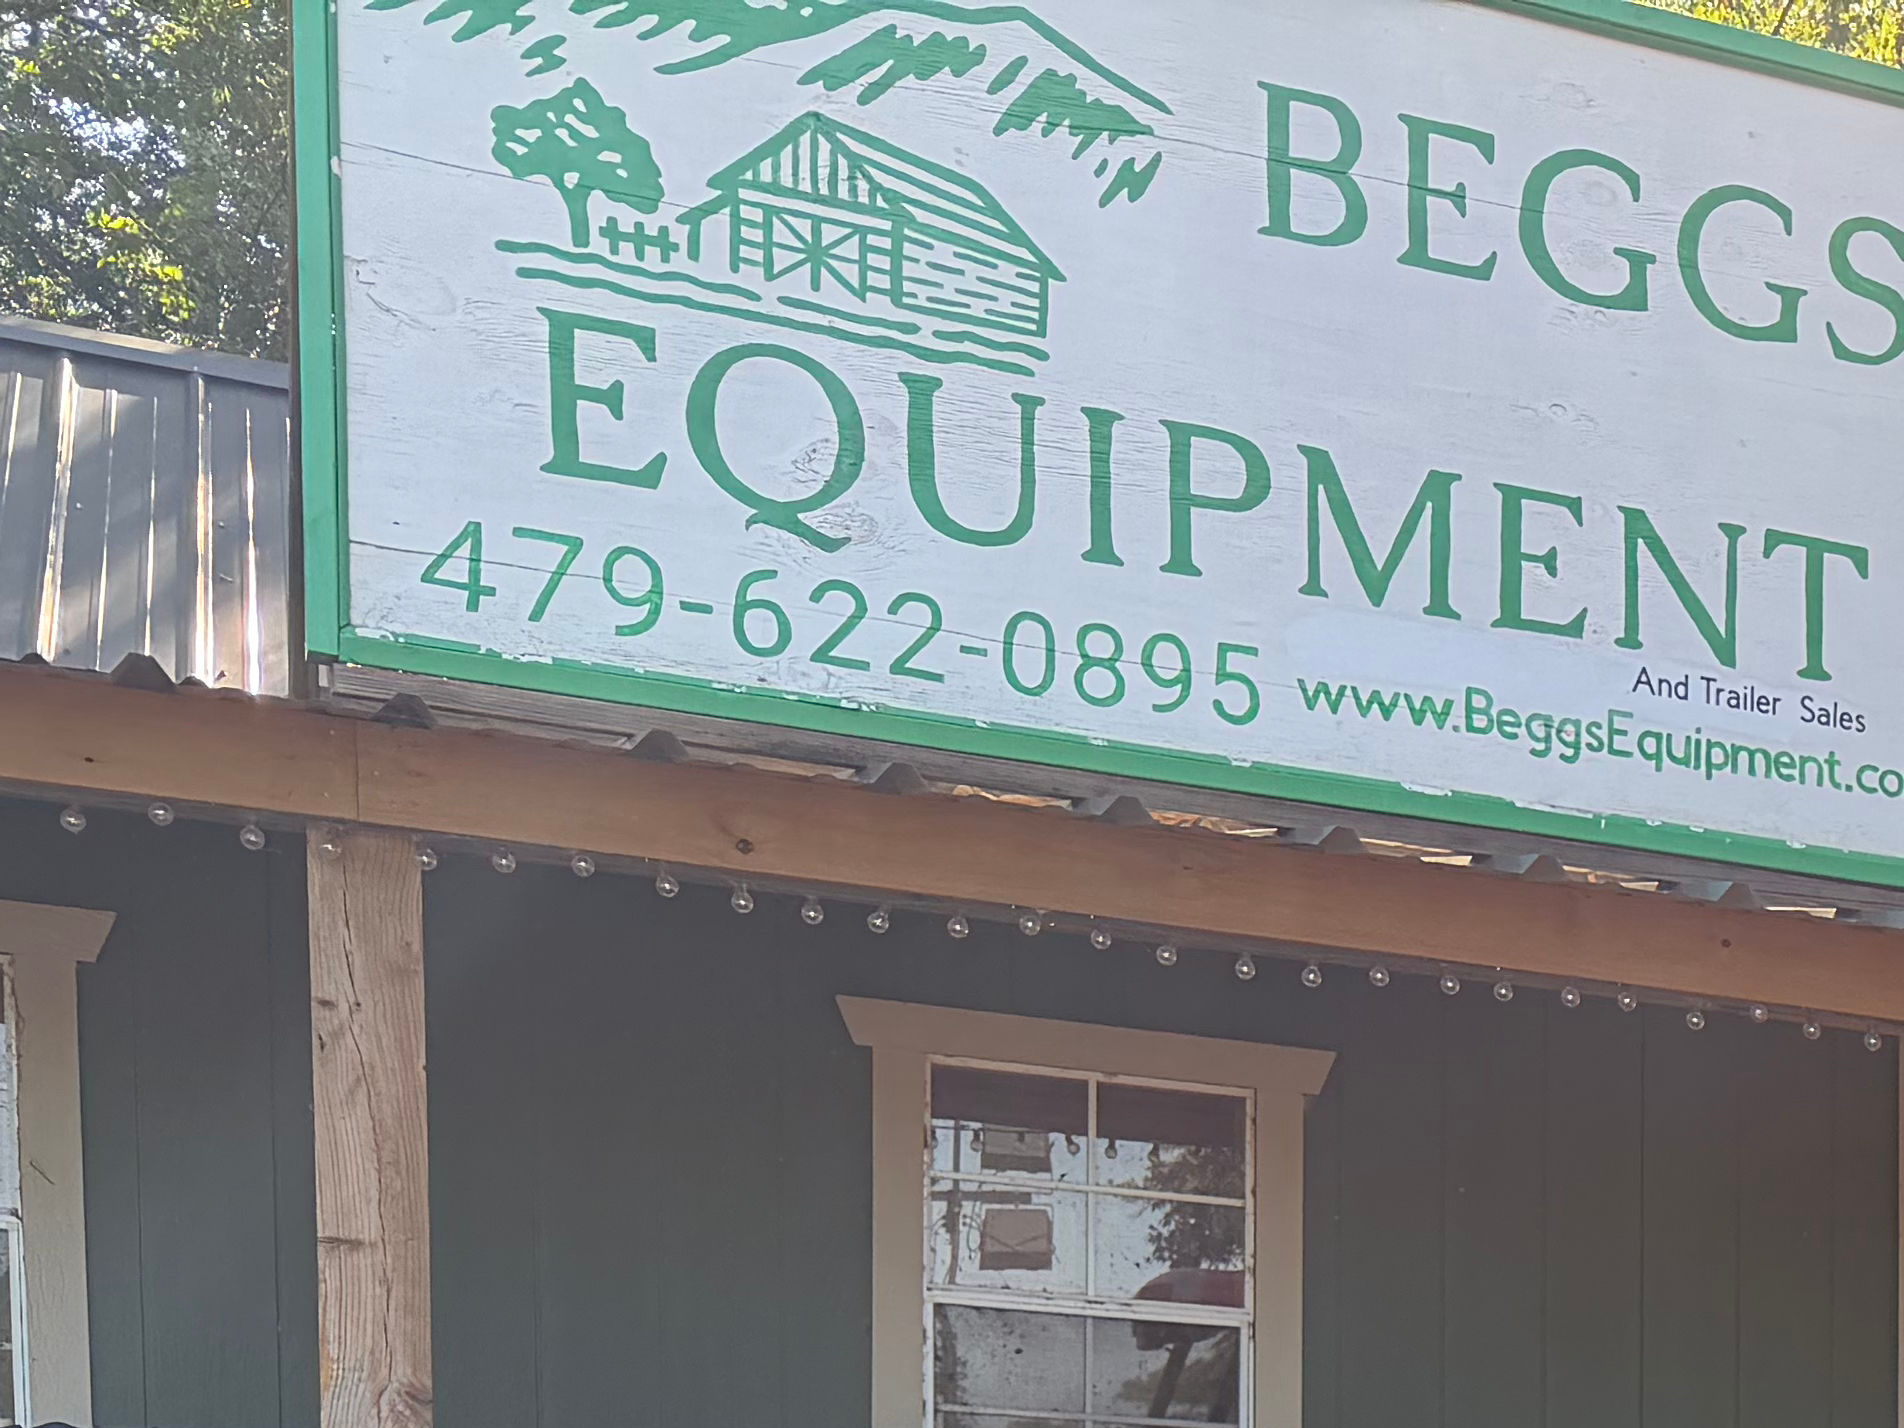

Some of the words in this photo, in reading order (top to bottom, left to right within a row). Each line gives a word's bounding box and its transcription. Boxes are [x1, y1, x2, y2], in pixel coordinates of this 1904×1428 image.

[539, 304, 1870, 683] EQUIPMENT
[419, 520, 1263, 728] 479-622-0895
[1632, 666, 1690, 702] And
[1699, 676, 1782, 717] Trailer
[1799, 695, 1867, 734] Sales
